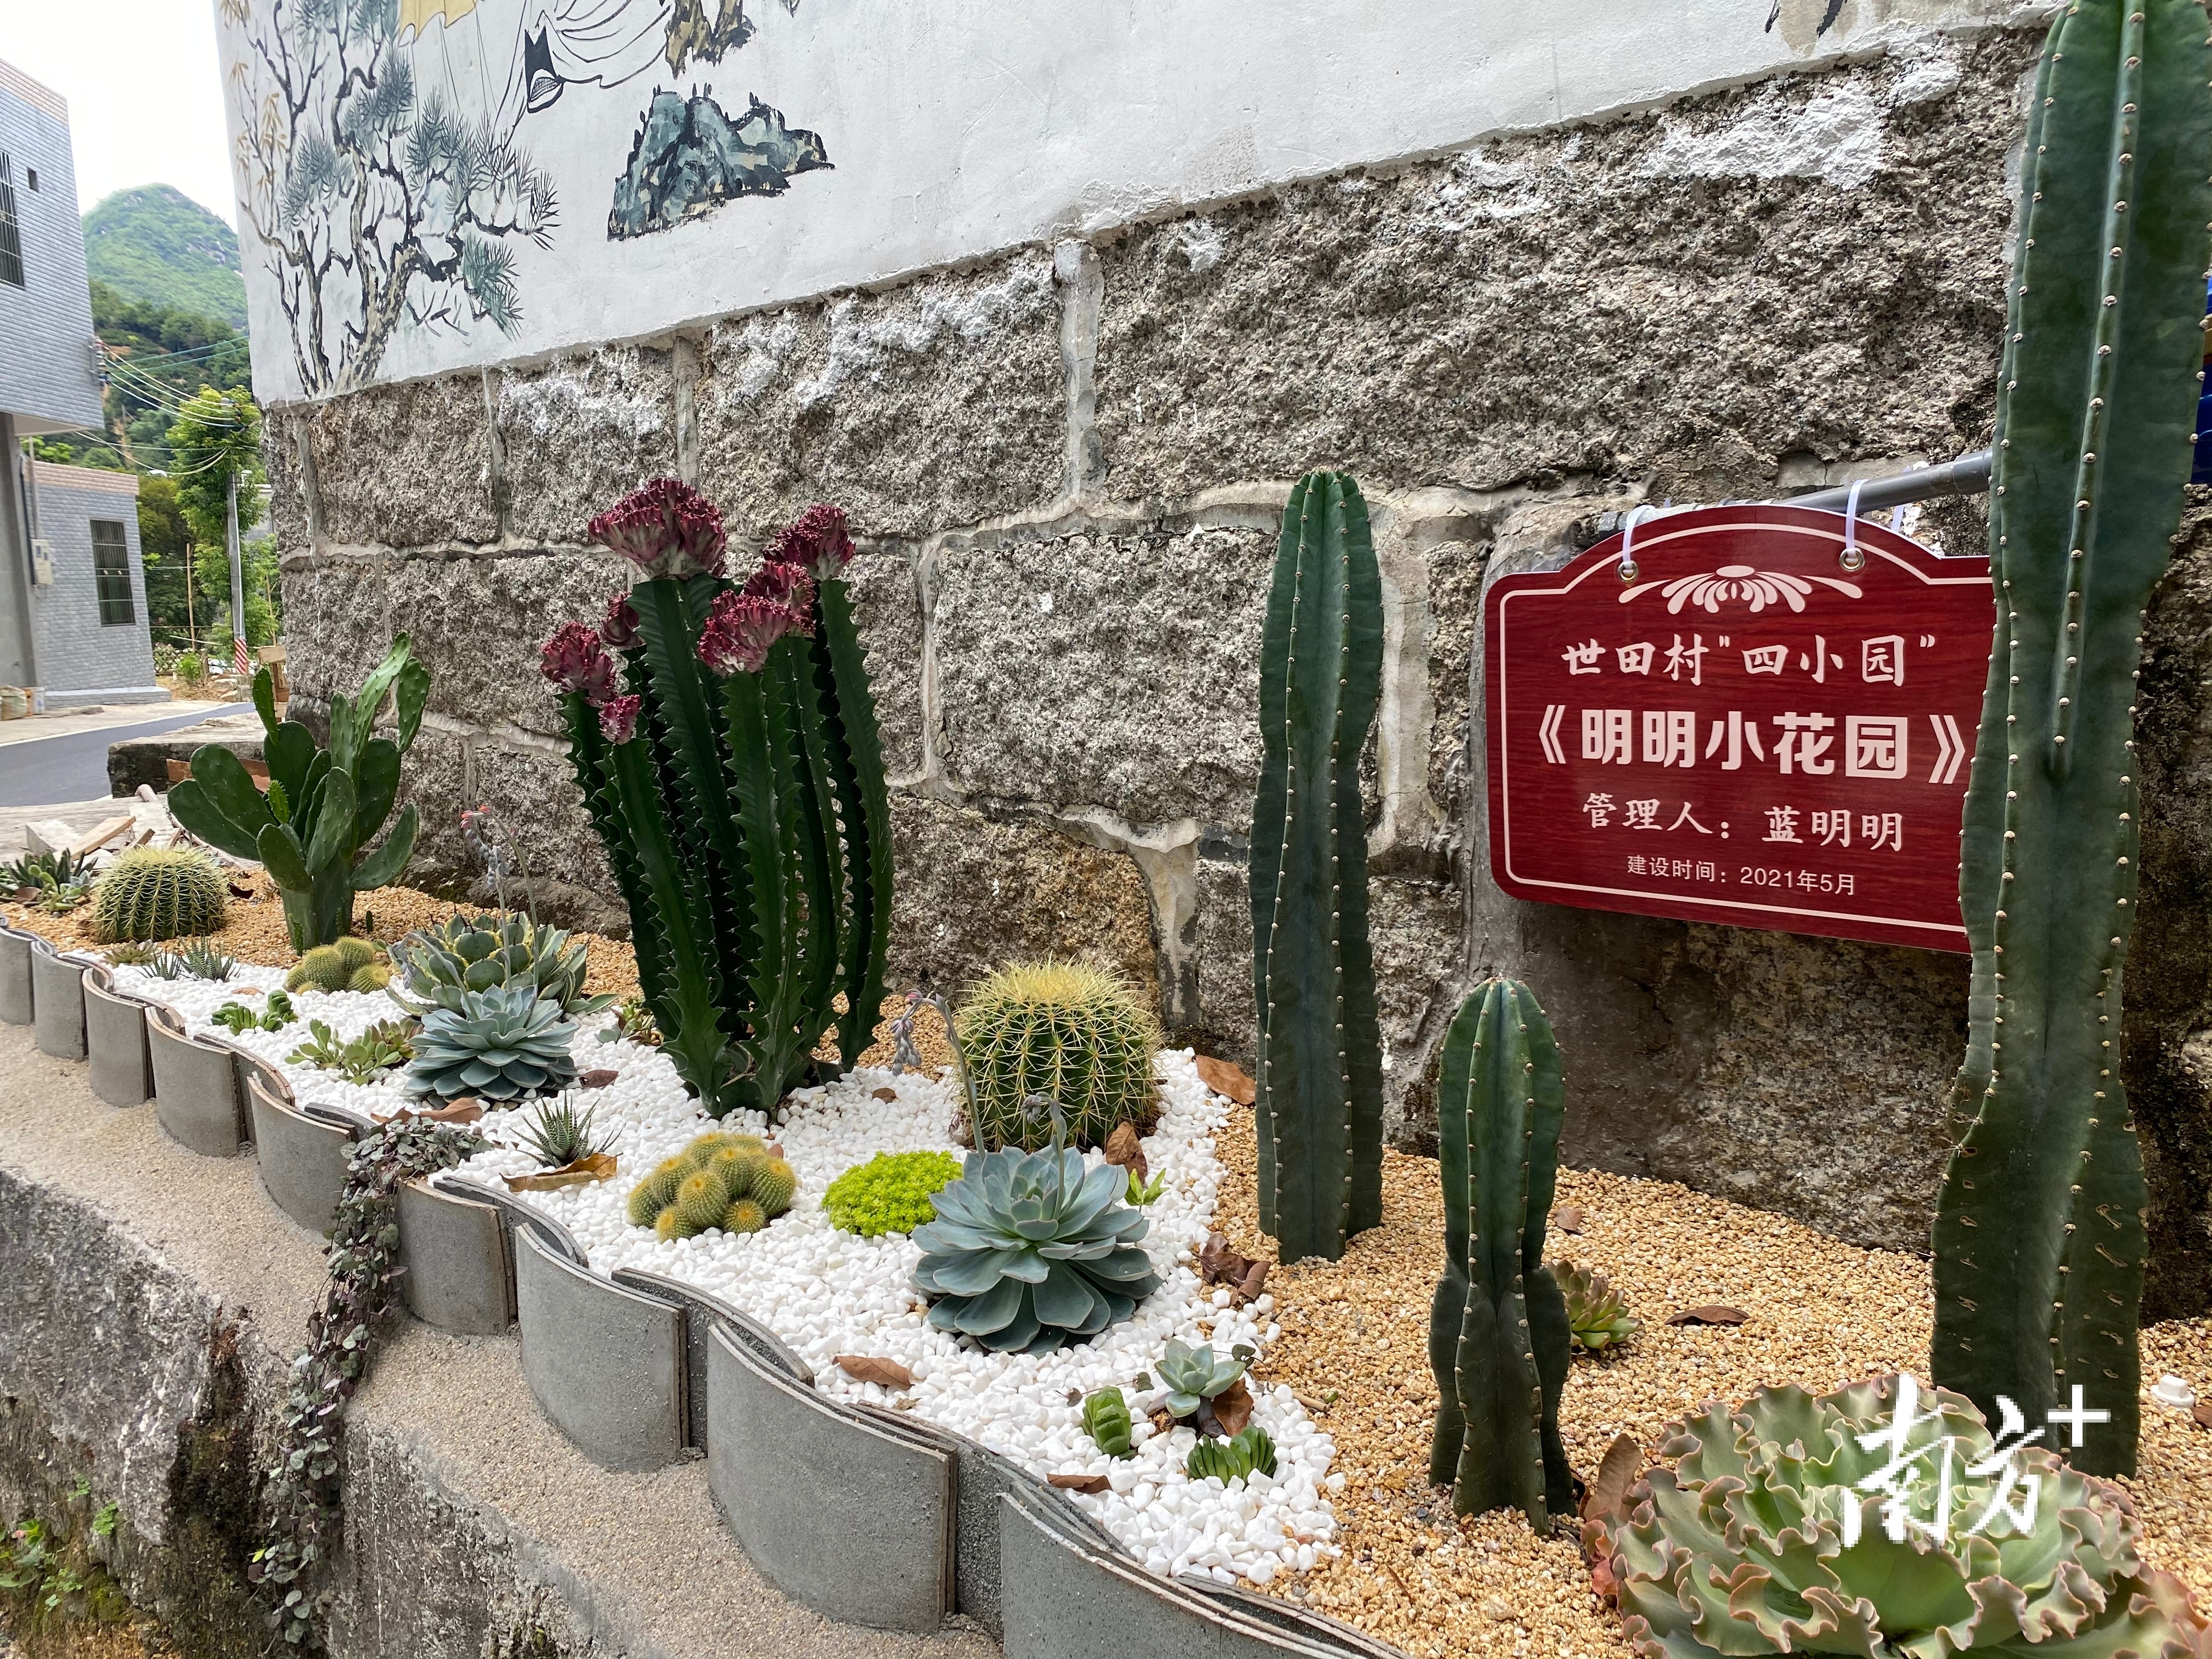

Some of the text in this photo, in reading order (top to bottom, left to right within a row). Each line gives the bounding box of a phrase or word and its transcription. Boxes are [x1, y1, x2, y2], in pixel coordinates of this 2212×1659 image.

[1538, 704, 1966, 785] 《明明小花园》
[1582, 792, 1903, 852] 管理人：蓝明明
[1627, 854, 1855, 896] 建设时间：2021年5月
